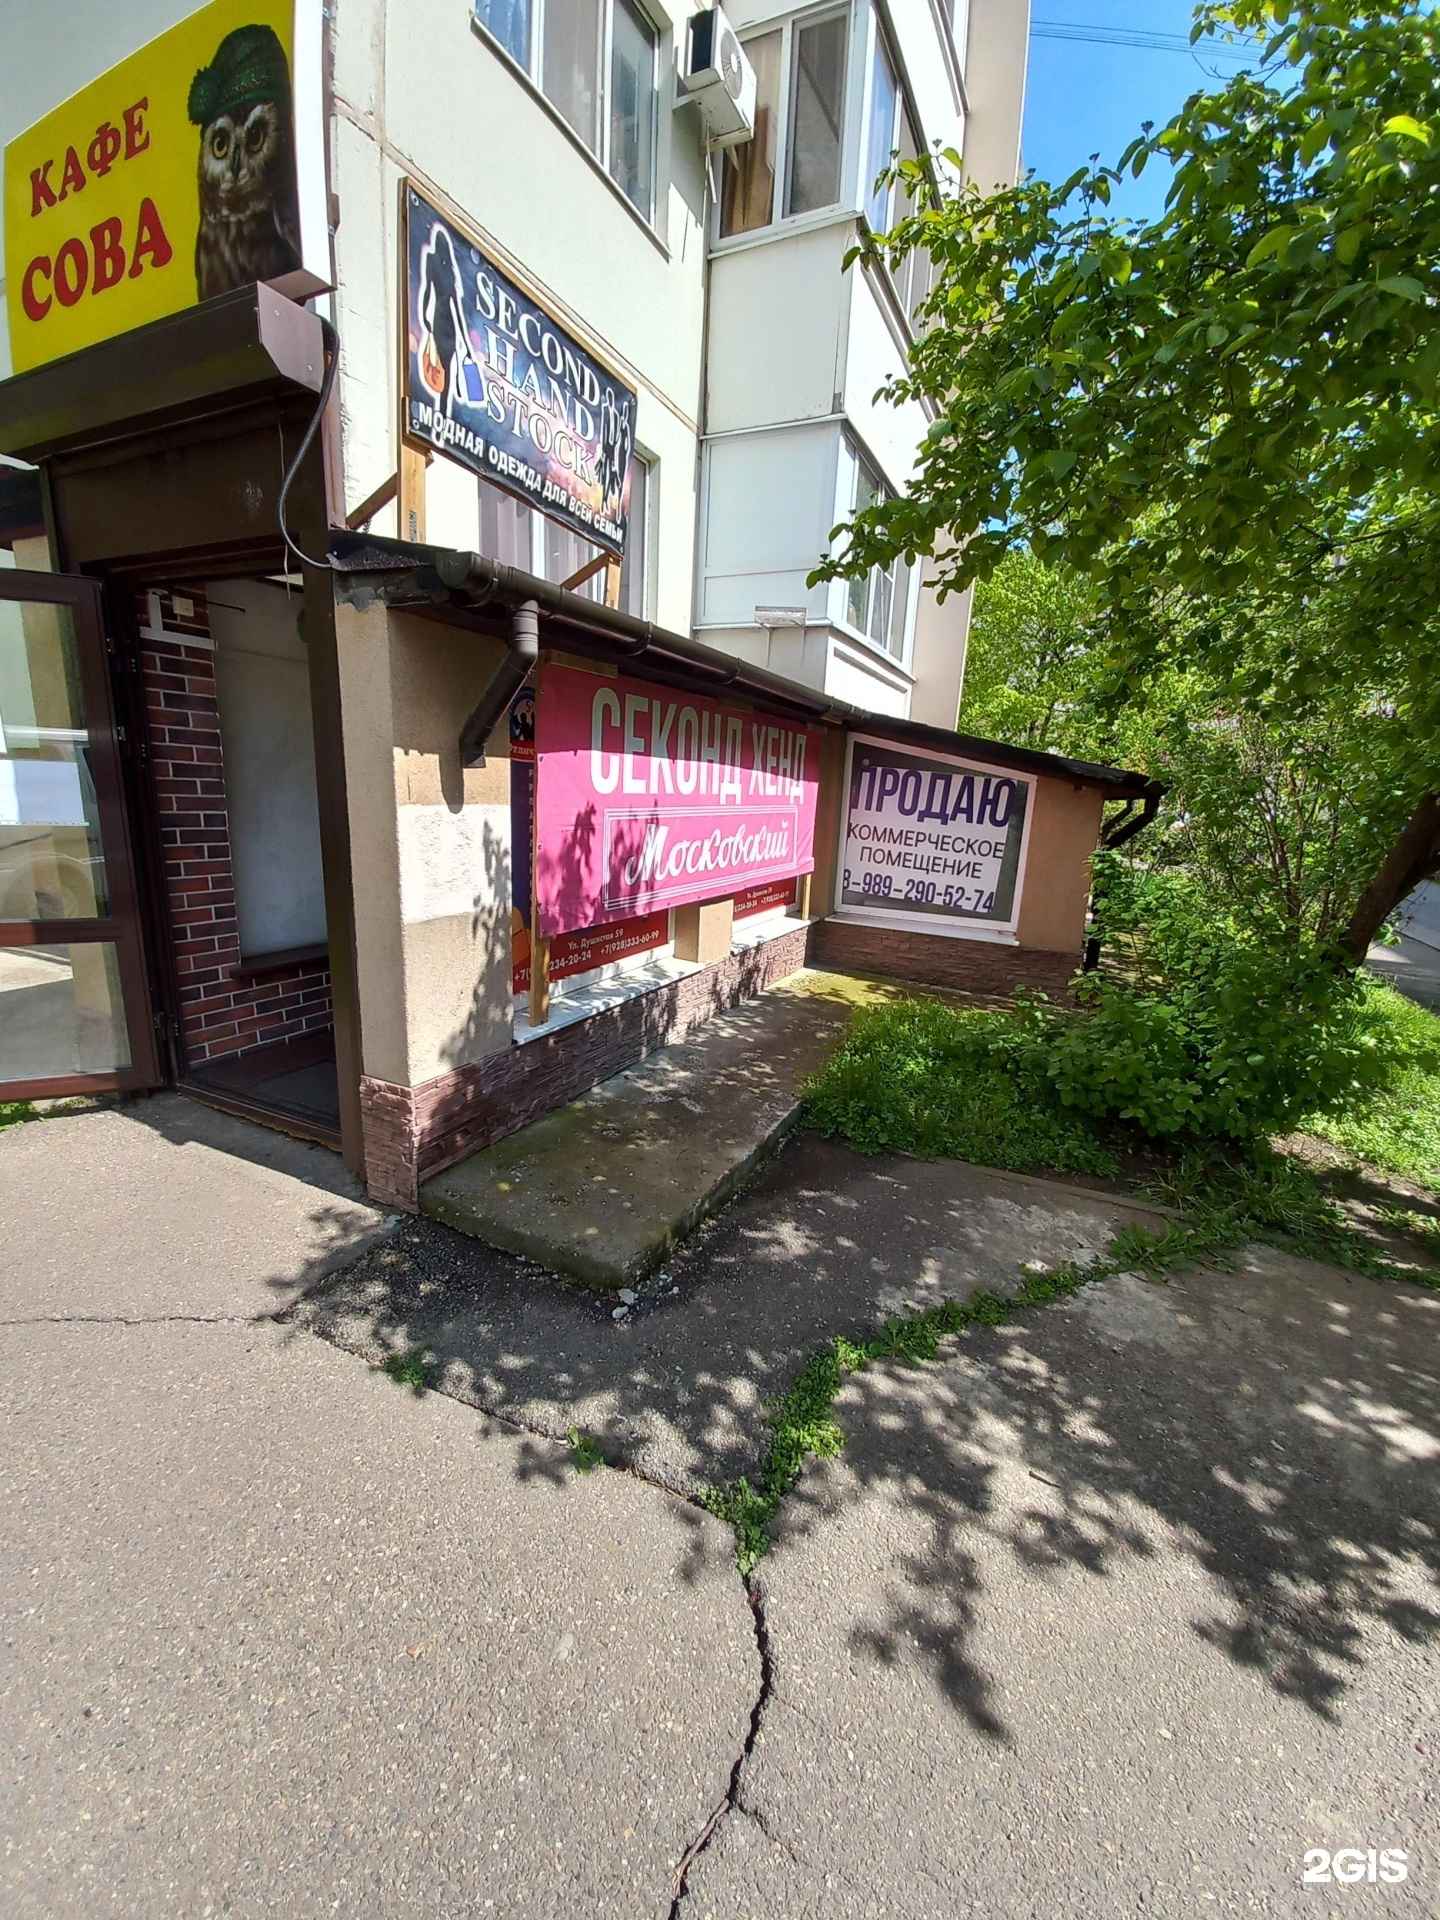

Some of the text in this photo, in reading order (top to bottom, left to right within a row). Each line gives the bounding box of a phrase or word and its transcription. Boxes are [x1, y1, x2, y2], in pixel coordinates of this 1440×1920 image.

[30, 96, 150, 217] КАФЕ
[21, 197, 173, 321] СОВА
[475, 271, 600, 407] SECOND
[484, 325, 595, 442] HAND
[418, 405, 624, 543] МОДНАЯ ОДЕЖДА ДЛЯ ВСЕЙ СЕМЬИ
[486, 379, 594, 486] STOCK
[590, 687, 807, 806] СЕКОНД ХЕНД
[850, 765, 1017, 828] ПРОДАЮ
[624, 820, 789, 885] Московский
[848, 822, 1007, 860] КОММЕРЧЕСКОЕ
[859, 846, 983, 879] ПОМЕЩЕНИЕ
